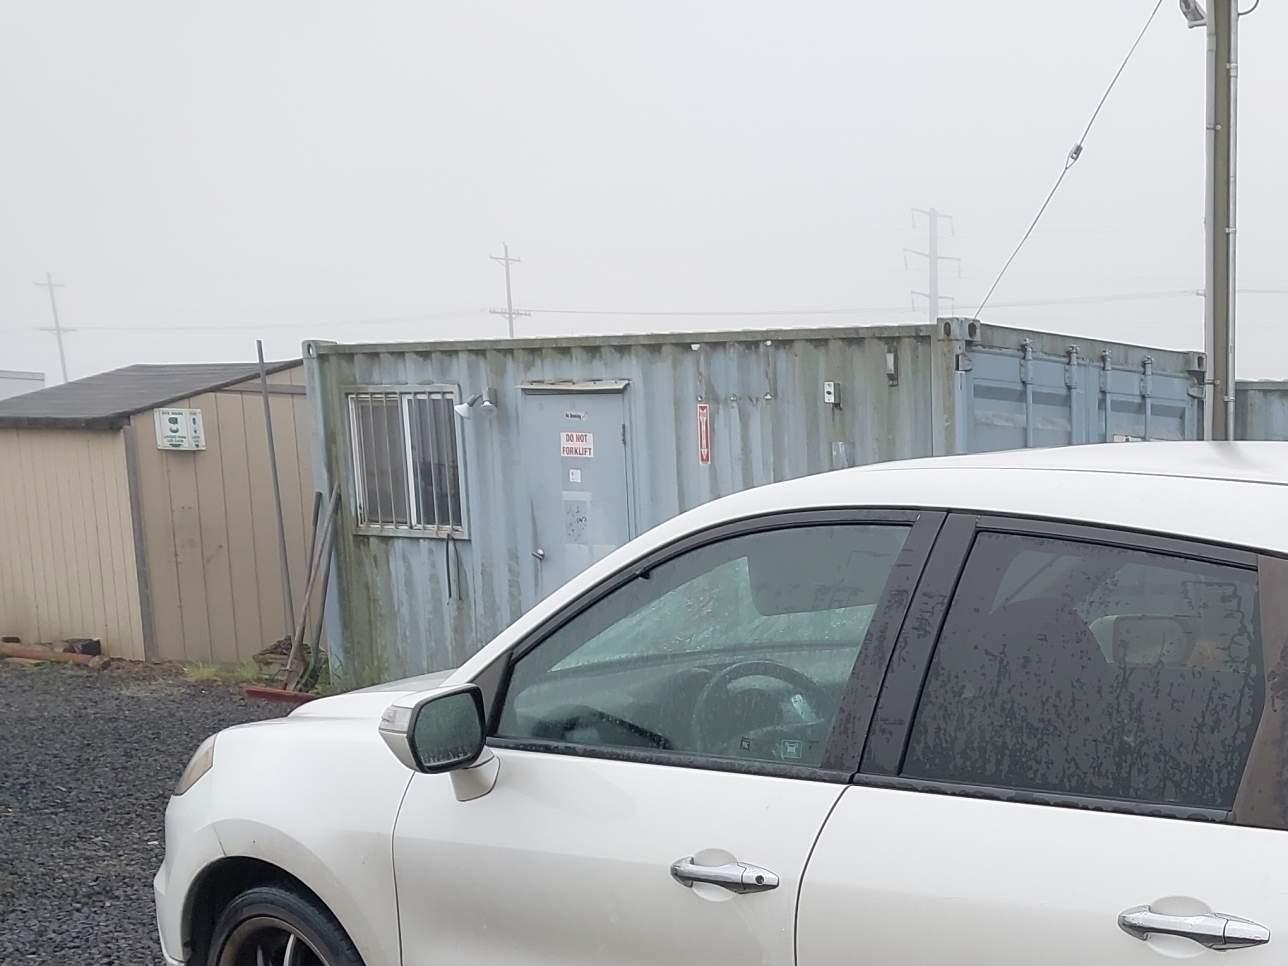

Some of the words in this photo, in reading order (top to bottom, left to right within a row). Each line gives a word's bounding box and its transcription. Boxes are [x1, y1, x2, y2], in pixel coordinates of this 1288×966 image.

[565, 434, 574, 443] DO
[575, 434, 588, 443] NOT
[562, 446, 592, 456] FORKLIFT
